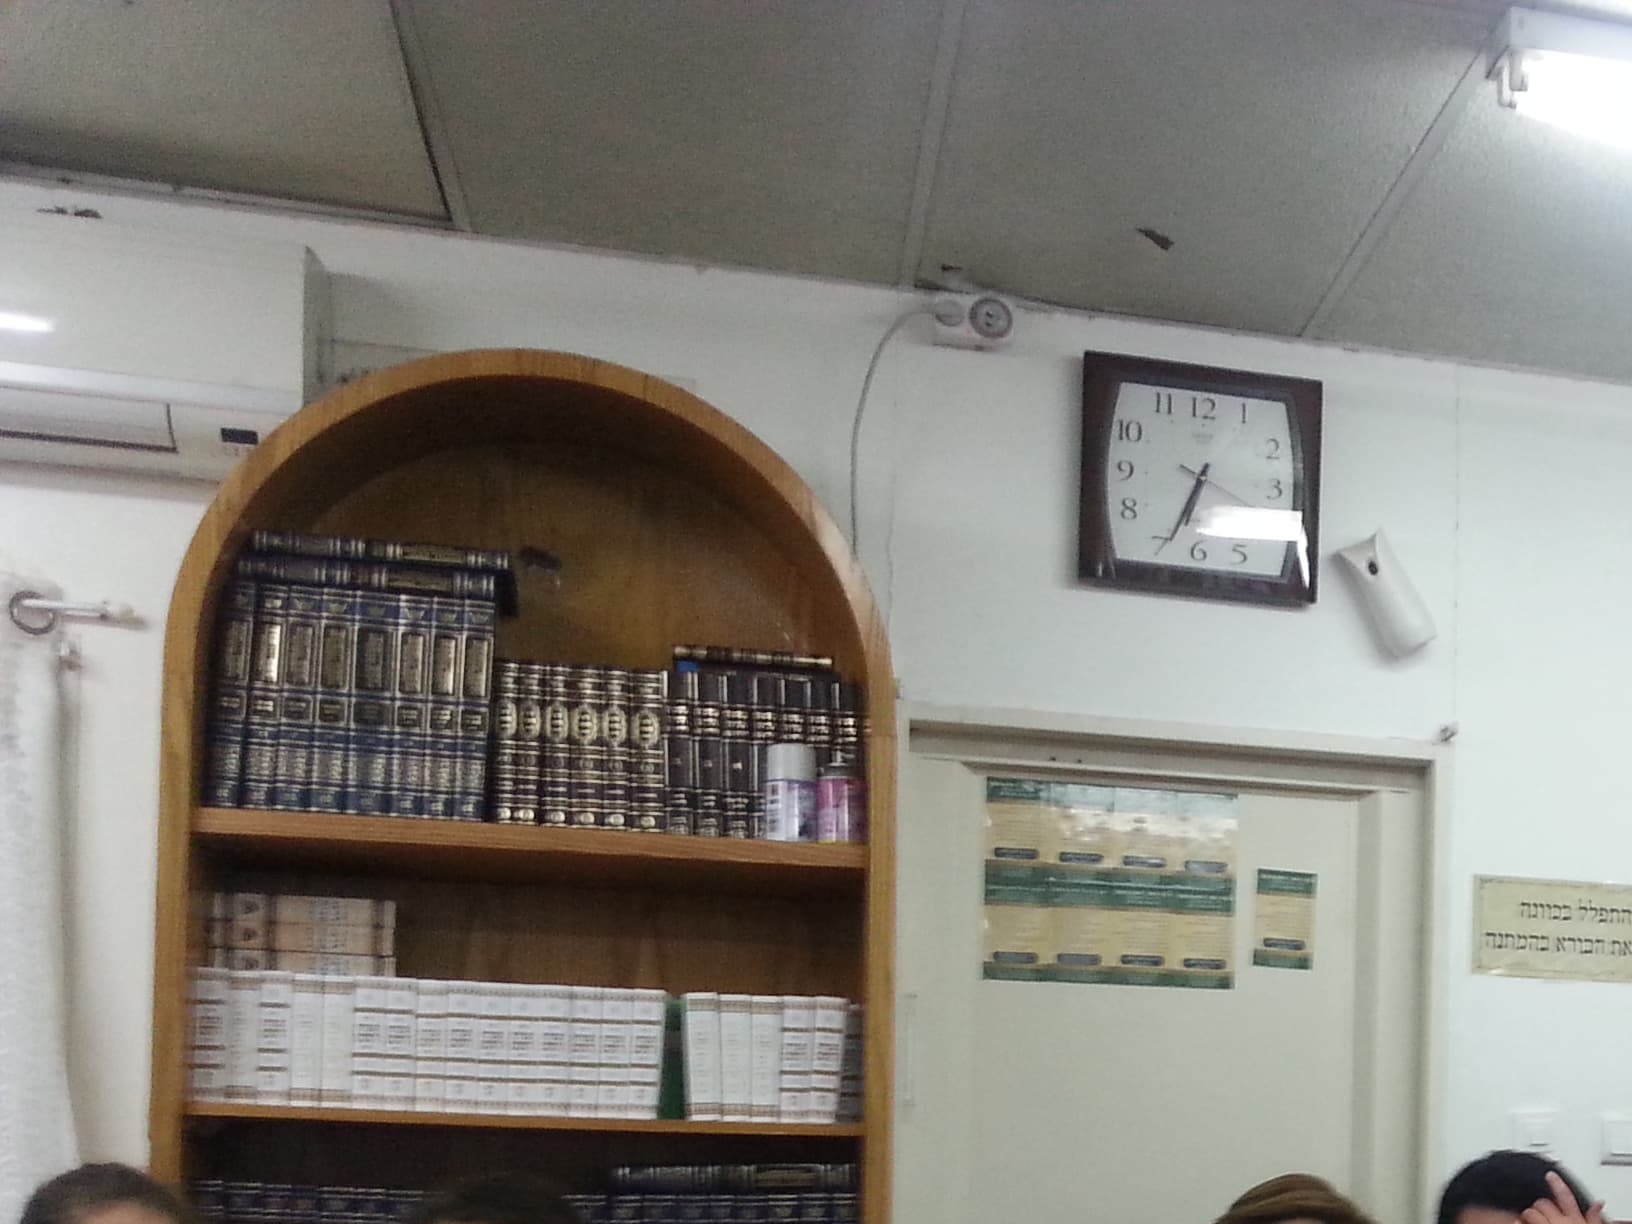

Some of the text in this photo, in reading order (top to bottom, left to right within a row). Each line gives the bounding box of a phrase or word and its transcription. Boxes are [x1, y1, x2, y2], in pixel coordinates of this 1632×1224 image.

[1155, 392, 1173, 416] 11
[1191, 396, 1217, 420] 12
[1240, 402, 1248, 425] 1
[1117, 419, 1143, 443] 10
[1265, 438, 1281, 460] 2
[1116, 460, 1135, 481] 9
[1265, 478, 1283, 501] 3
[1120, 498, 1138, 521] 8
[1151, 534, 1171, 557] 7
[1190, 541, 1208, 562] 6
[1230, 544, 1248, 566] 5
[1520, 901, 1572, 921] בכוונה
[1485, 931, 1549, 952] בהמתנה
[1556, 935, 1605, 955] הבורא
[1612, 939, 1632, 957] את
